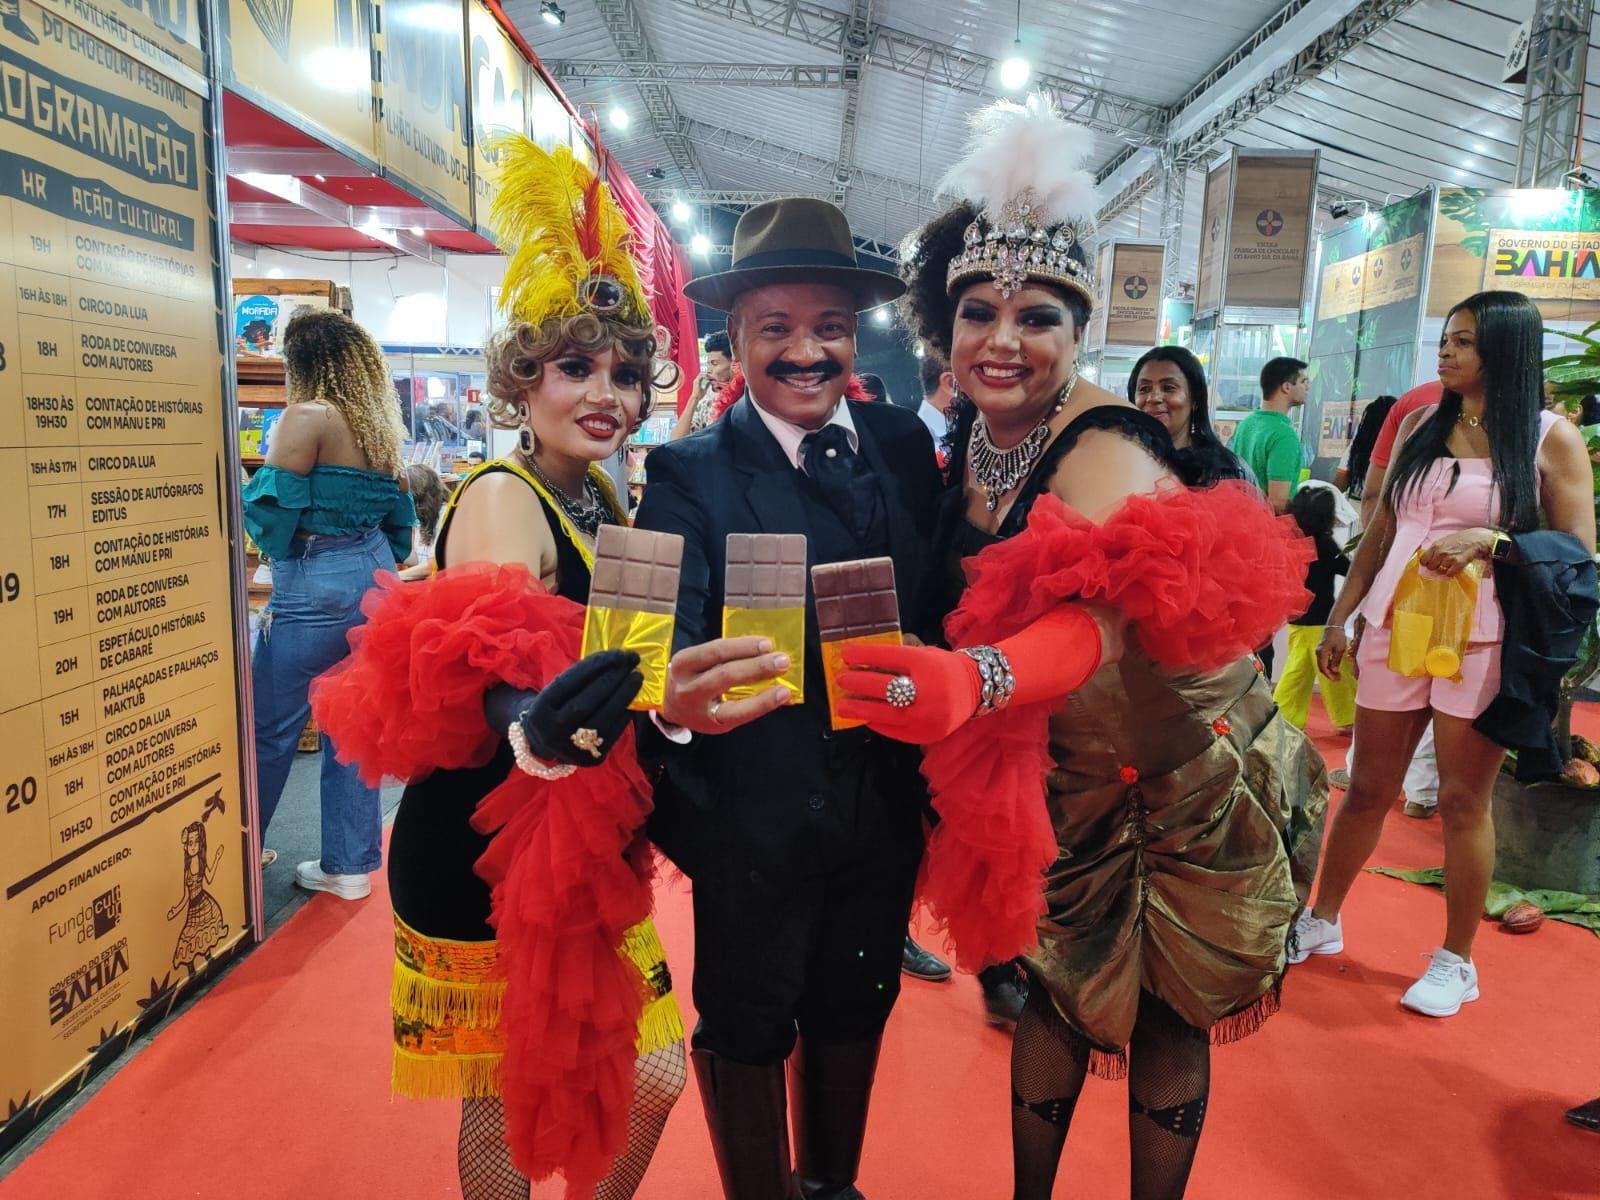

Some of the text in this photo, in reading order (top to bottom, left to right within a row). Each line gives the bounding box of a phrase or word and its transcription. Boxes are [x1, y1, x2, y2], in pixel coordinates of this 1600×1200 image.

[41, 11, 188, 109] DO CHOCOLAT FESTIVAL
[0, 61, 188, 184] OGRAMAÇÃO
[21, 169, 47, 200] HR
[72, 187, 184, 242] AÇÃO CULTURAL
[30, 234, 51, 254] 19H
[1498, 238, 1550, 249] GOVERNO
[1553, 240, 1567, 249] DO
[1495, 249, 1600, 277] BAHIA
[38, 288, 51, 303] ÀS
[52, 293, 67, 306] 18H
[79, 296, 148, 321] CIRCO DA LUA
[37, 340, 58, 357] 18H
[81, 333, 177, 359] RODA DE CONVERSA
[82, 353, 153, 373] COM AUTORES
[26, 394, 74, 411] 18H30 ÀS
[85, 395, 203, 416] CONTAÇÃO DE HISTÓRIAS
[35, 415, 68, 429] 19H30
[86, 415, 166, 430] COM MANU E PRI
[49, 459, 61, 474] ÀS
[62, 461, 77, 473] 17H
[88, 455, 156, 471] CIRCO DA LUA
[91, 482, 204, 506] SESSÃO DE AUTÓGRAFOS
[47, 504, 67, 519] 17H
[92, 506, 128, 524] EDITUS
[94, 525, 210, 556] CONTAÇÃO DE HISTÓRIAS
[50, 554, 70, 570] 18H
[95, 547, 173, 573] COM MANU E PRI
[96, 573, 189, 606] RODA DE CONVERSA
[53, 607, 74, 624] 19H
[97, 595, 167, 624] COM AUTORES
[99, 610, 206, 654] ESPETÁCULO HISTÓRIAS
[55, 656, 78, 675] 20H
[100, 642, 153, 671] DE CABARÉ
[103, 650, 219, 701] PALHAÇADAS E PALHAÇOS
[59, 708, 79, 727] 15H
[104, 691, 146, 719] MAKTUB
[105, 708, 171, 745] CIRCO DA LUA
[49, 740, 94, 768] 16H ÀS 18H
[106, 717, 198, 768] RODA DE CONVERSA
[107, 743, 175, 785] COM AUTORES
[109, 742, 222, 807] CONTAÇÃO DE HISTÓRIAS
[5, 776, 37, 814] 20
[64, 777, 84, 797] 18H
[110, 775, 186, 824] COM MANU E PRI
[60, 816, 93, 843] 19H30
[31, 847, 132, 913] APOIO FINANCEIRO:
[49, 904, 92, 944] Fundo
[77, 924, 94, 944] de
[49, 937, 128, 996] GOVERNO DO ESTADO
[49, 950, 129, 1026] BAHIA
